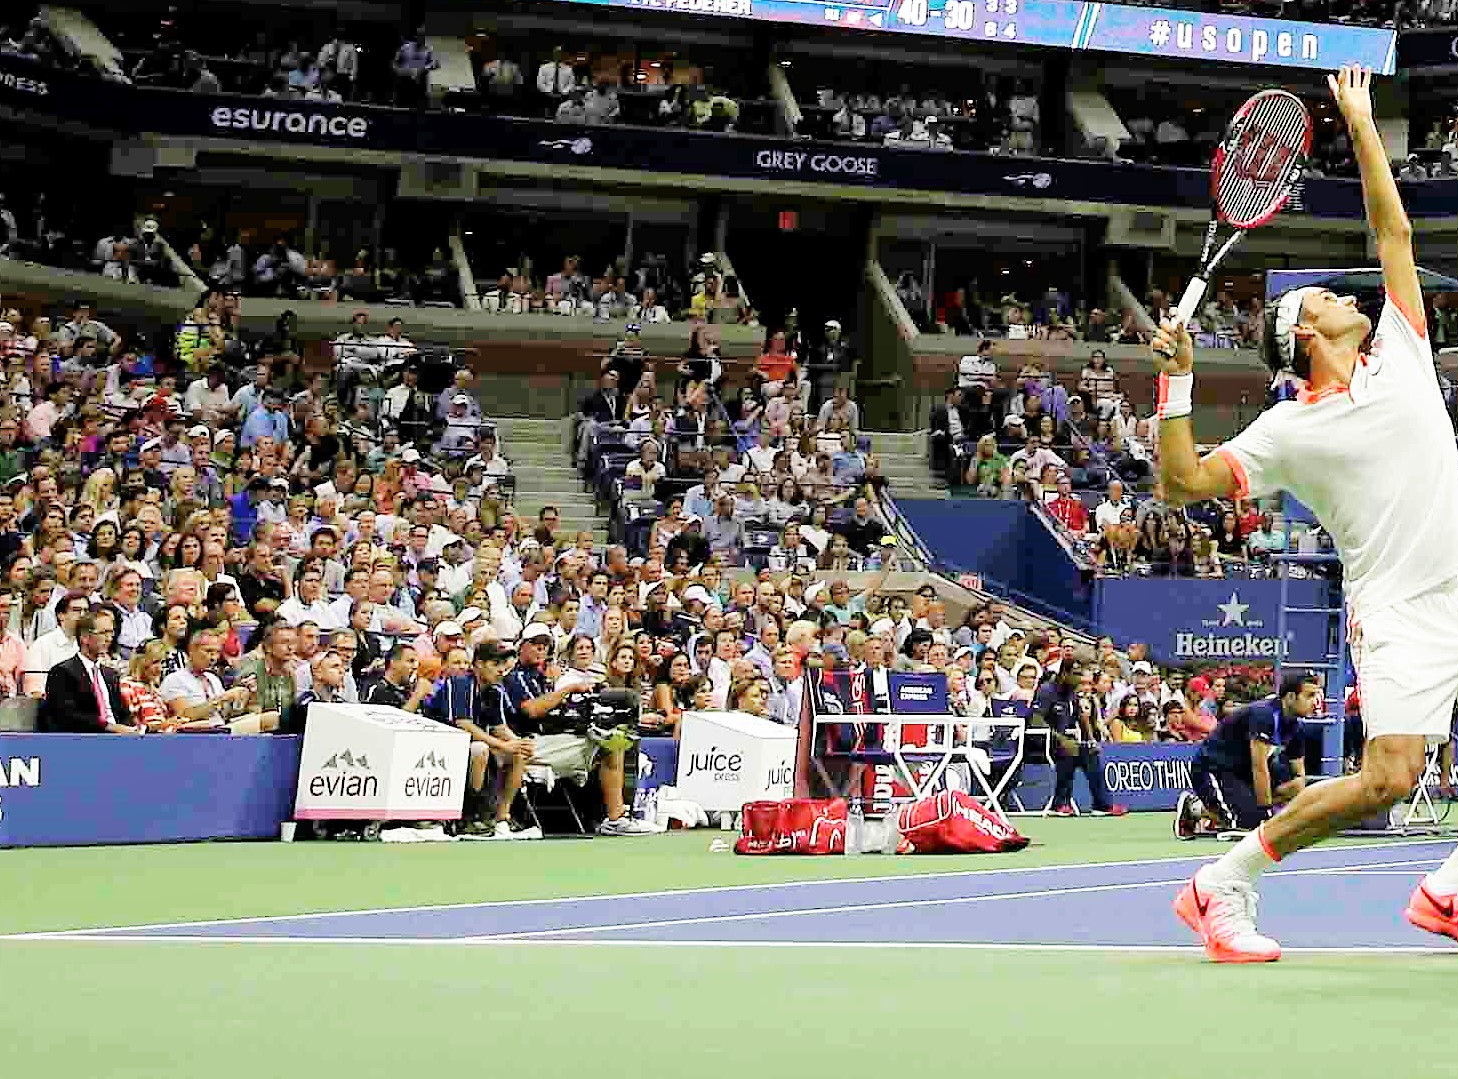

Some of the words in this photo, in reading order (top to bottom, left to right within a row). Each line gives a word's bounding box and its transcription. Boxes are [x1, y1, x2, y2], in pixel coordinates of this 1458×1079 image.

[1149, 18, 1320, 62] #usopen
[211, 103, 369, 139] esurance
[756, 149, 808, 171] GREY
[809, 154, 880, 177] GOOSE
[1176, 630, 1290, 658] Heineken
[686, 745, 743, 778] juice
[764, 759, 793, 792] juic
[1104, 760, 1153, 792] OREO
[309, 771, 378, 798] evian
[404, 772, 452, 798] evian
